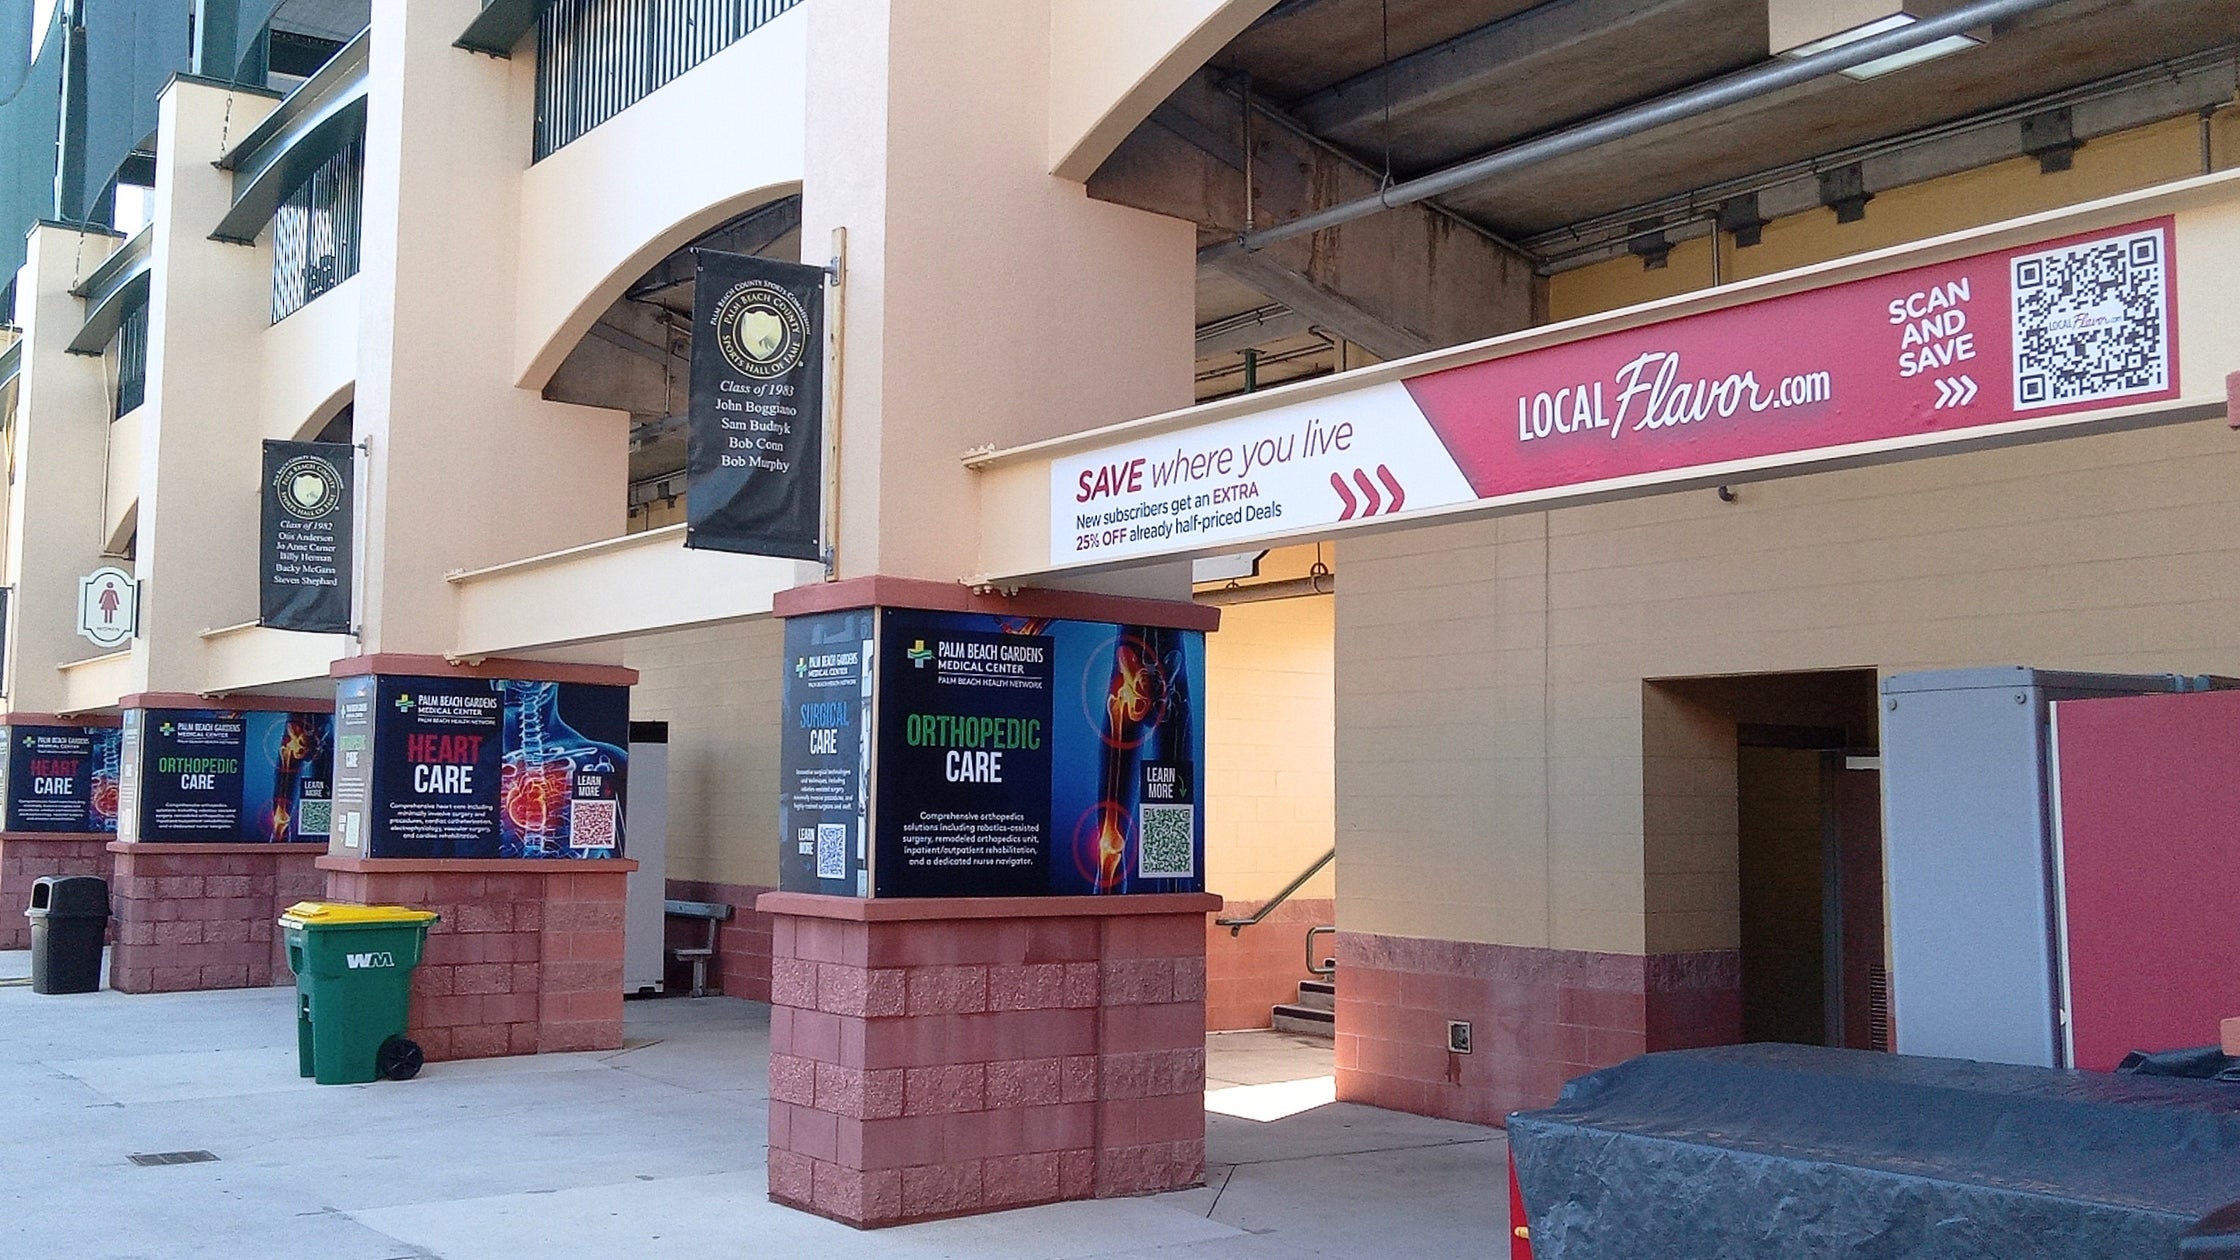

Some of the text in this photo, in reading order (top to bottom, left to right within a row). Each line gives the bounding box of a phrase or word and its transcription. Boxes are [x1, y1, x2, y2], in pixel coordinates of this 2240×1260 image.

[710, 307, 720, 326] PALM
[735, 279, 762, 291] COUNTY
[764, 280, 787, 295] SPORTS
[1888, 277, 1970, 325] SCAN
[723, 292, 801, 334] PALM BEACH COUNTY
[1901, 309, 1966, 350] AND
[722, 335, 801, 375] SPORTS HALL OF FAME
[1898, 332, 1976, 377] SAVE
[720, 380, 795, 397] Class of 1983
[715, 398, 797, 416] John Boggiano
[721, 417, 791, 436] Sam Budnyk
[728, 436, 784, 452] Bob Conn
[721, 455, 790, 473] Bob Murphy
[1076, 418, 1353, 503] SAVE where you live
[1076, 481, 1259, 530] New subscribers get an EXTRA
[280, 520, 333, 531] Class of 1982
[1076, 501, 1282, 551] 25% OFF already half-priced Deals
[276, 541, 286, 550] Jo
[938, 641, 1044, 663] PALM BEACH GARDENS
[938, 659, 1024, 674] MEDICAL CENTER
[938, 676, 1042, 689] PALM BEACH HEALTH NETWORK
[418, 695, 497, 708] PALM BEACH GARDENS
[800, 701, 850, 728] SURGICAL
[907, 713, 1041, 750] ORTHOPEDIC
[407, 733, 482, 764] HEART
[810, 729, 838, 754] CARE
[30, 759, 80, 776] HEART
[159, 757, 238, 774] ORTHOPEDIC
[945, 750, 1002, 783] CARE
[181, 774, 215, 790] CARE
[414, 764, 474, 794] CARE
[577, 775, 602, 786] LEARN
[1146, 766, 1176, 783] LEARN
[34, 777, 73, 795] CARE
[578, 786, 600, 797] MORE
[1148, 783, 1174, 799] MORE
[920, 811, 1024, 822] Comprehensive orthopedics
[798, 827, 815, 841] LEARN
[903, 823, 1040, 833] solutions including robotics-assisted
[902, 836, 934, 845] surgery,
[935, 835, 976, 843] remodeled
[976, 835, 1021, 845] orthopedics
[904, 845, 984, 856] inpatient/outpatient
[909, 857, 925, 865] and
[933, 857, 972, 865] dedicated
[995, 857, 1033, 867] navigator.
[346, 952, 395, 968] WM
